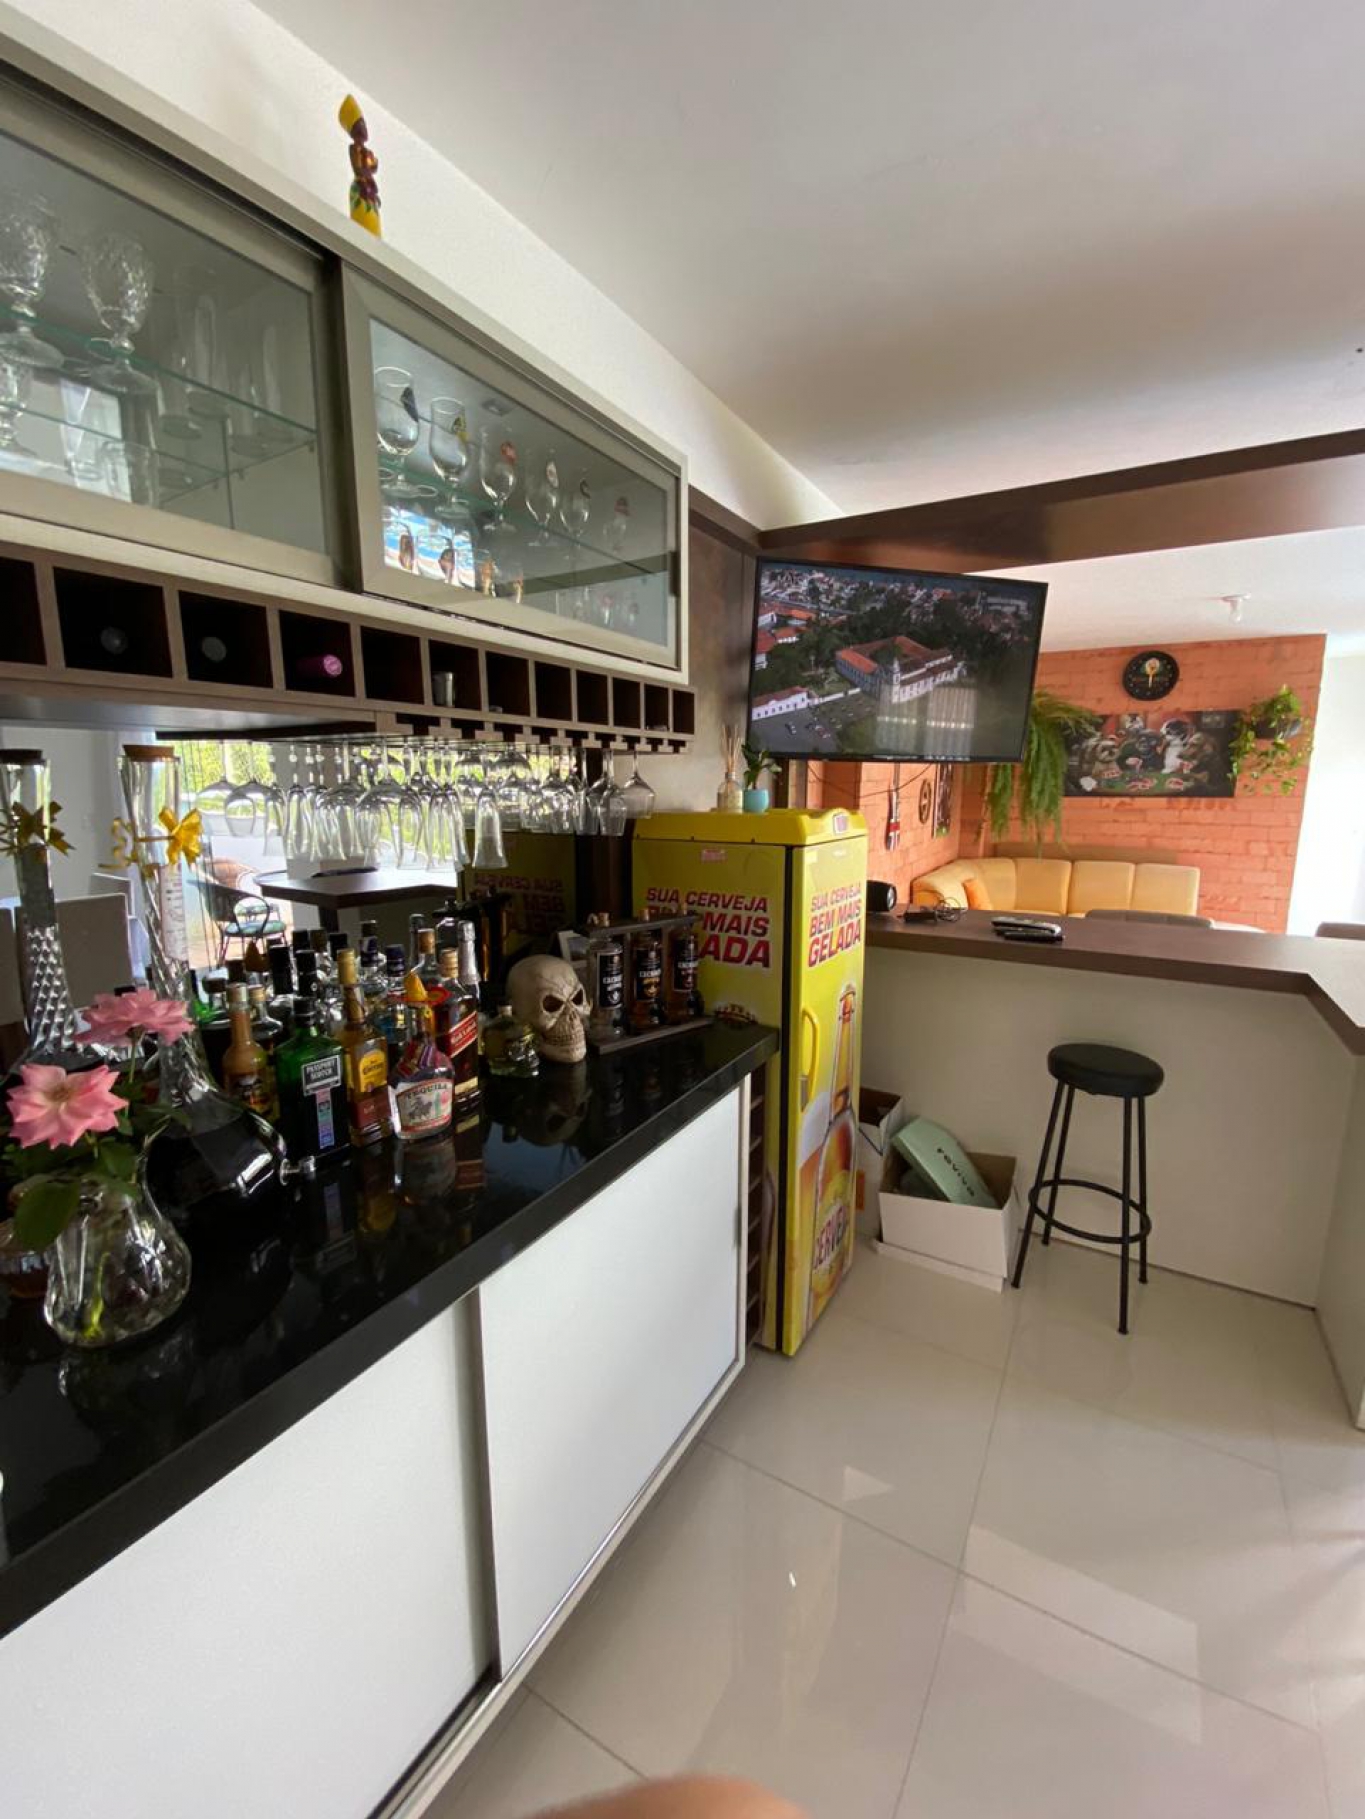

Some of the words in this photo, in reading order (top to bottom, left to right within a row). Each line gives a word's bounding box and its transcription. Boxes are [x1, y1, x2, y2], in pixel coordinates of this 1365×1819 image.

[647, 887, 680, 903] SUA
[685, 891, 768, 913] CERVEJA
[811, 891, 829, 912] SUA
[703, 911, 770, 937] MAIS
[810, 909, 836, 937] BEM
[838, 897, 862, 924] MAIS
[808, 918, 861, 968] GELADA
[404, 1082, 448, 1099] TEQUILA
